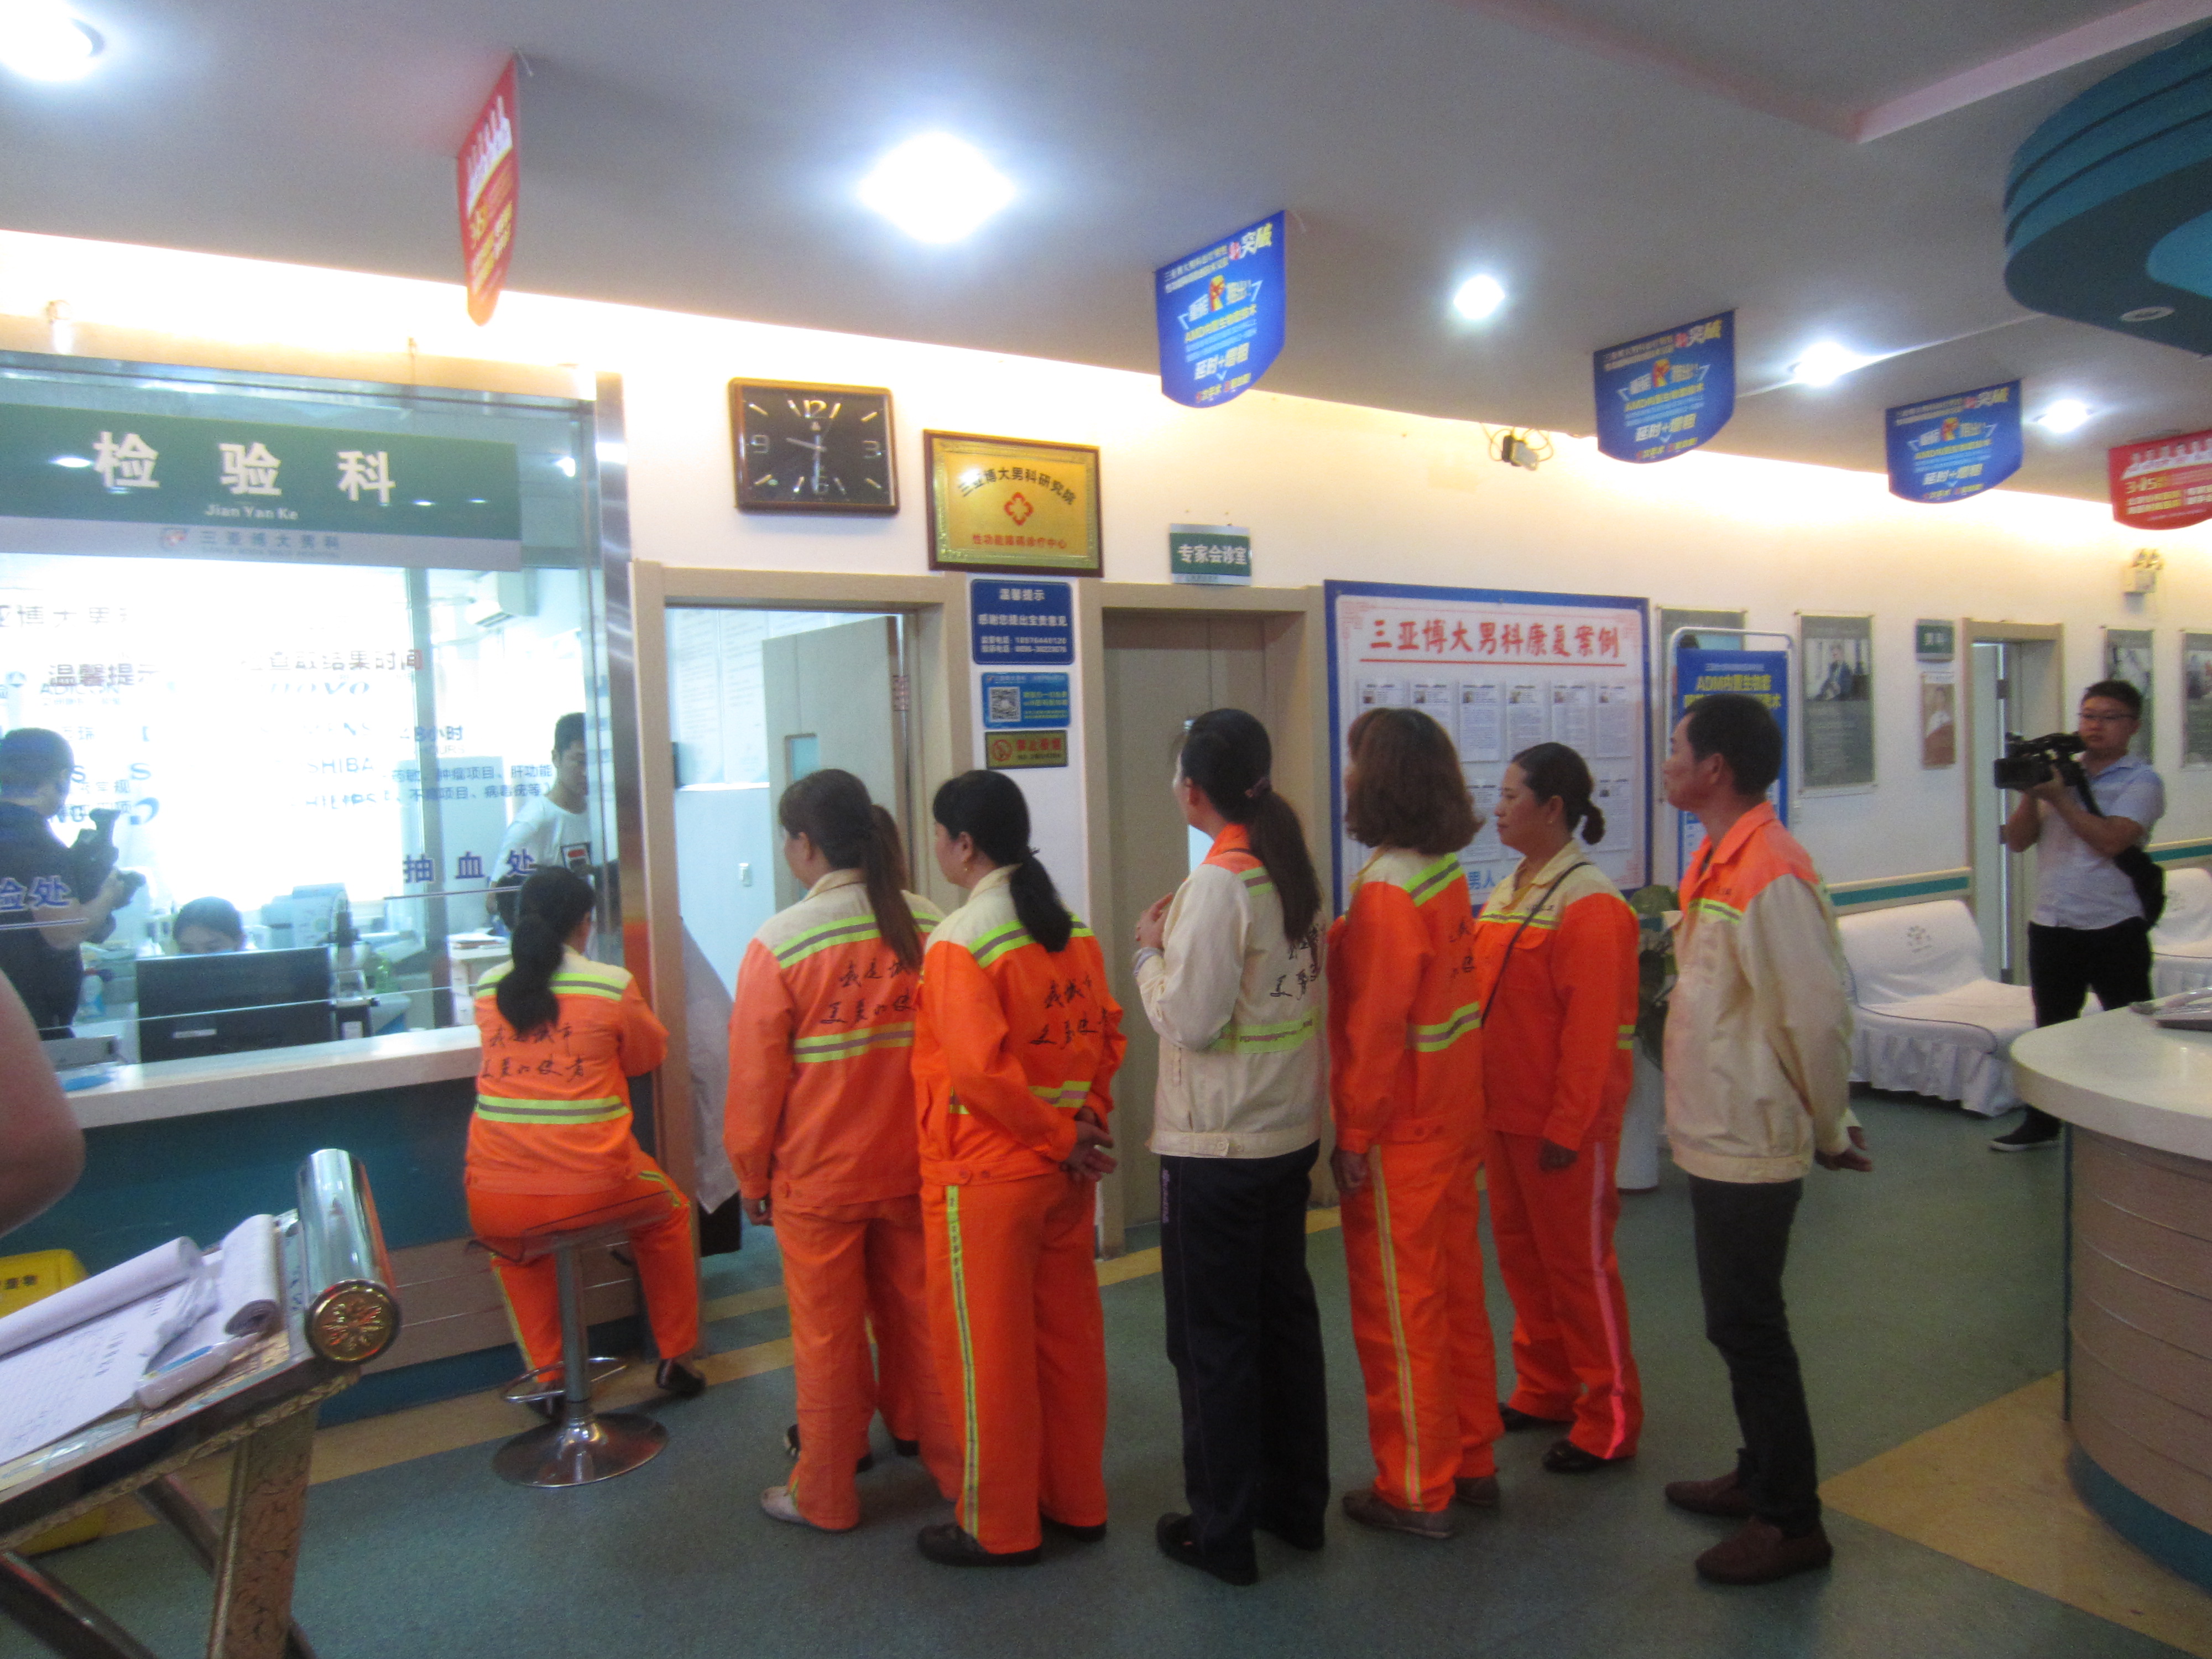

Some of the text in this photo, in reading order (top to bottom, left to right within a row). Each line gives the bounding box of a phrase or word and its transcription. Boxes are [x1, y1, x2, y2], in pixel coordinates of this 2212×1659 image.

[93, 431, 396, 504] 检验科
[205, 504, 299, 519] Jian Yan Ke
[1369, 618, 1620, 659] 三亚博大男科康复案例
[403, 848, 535, 884] 抽血处
